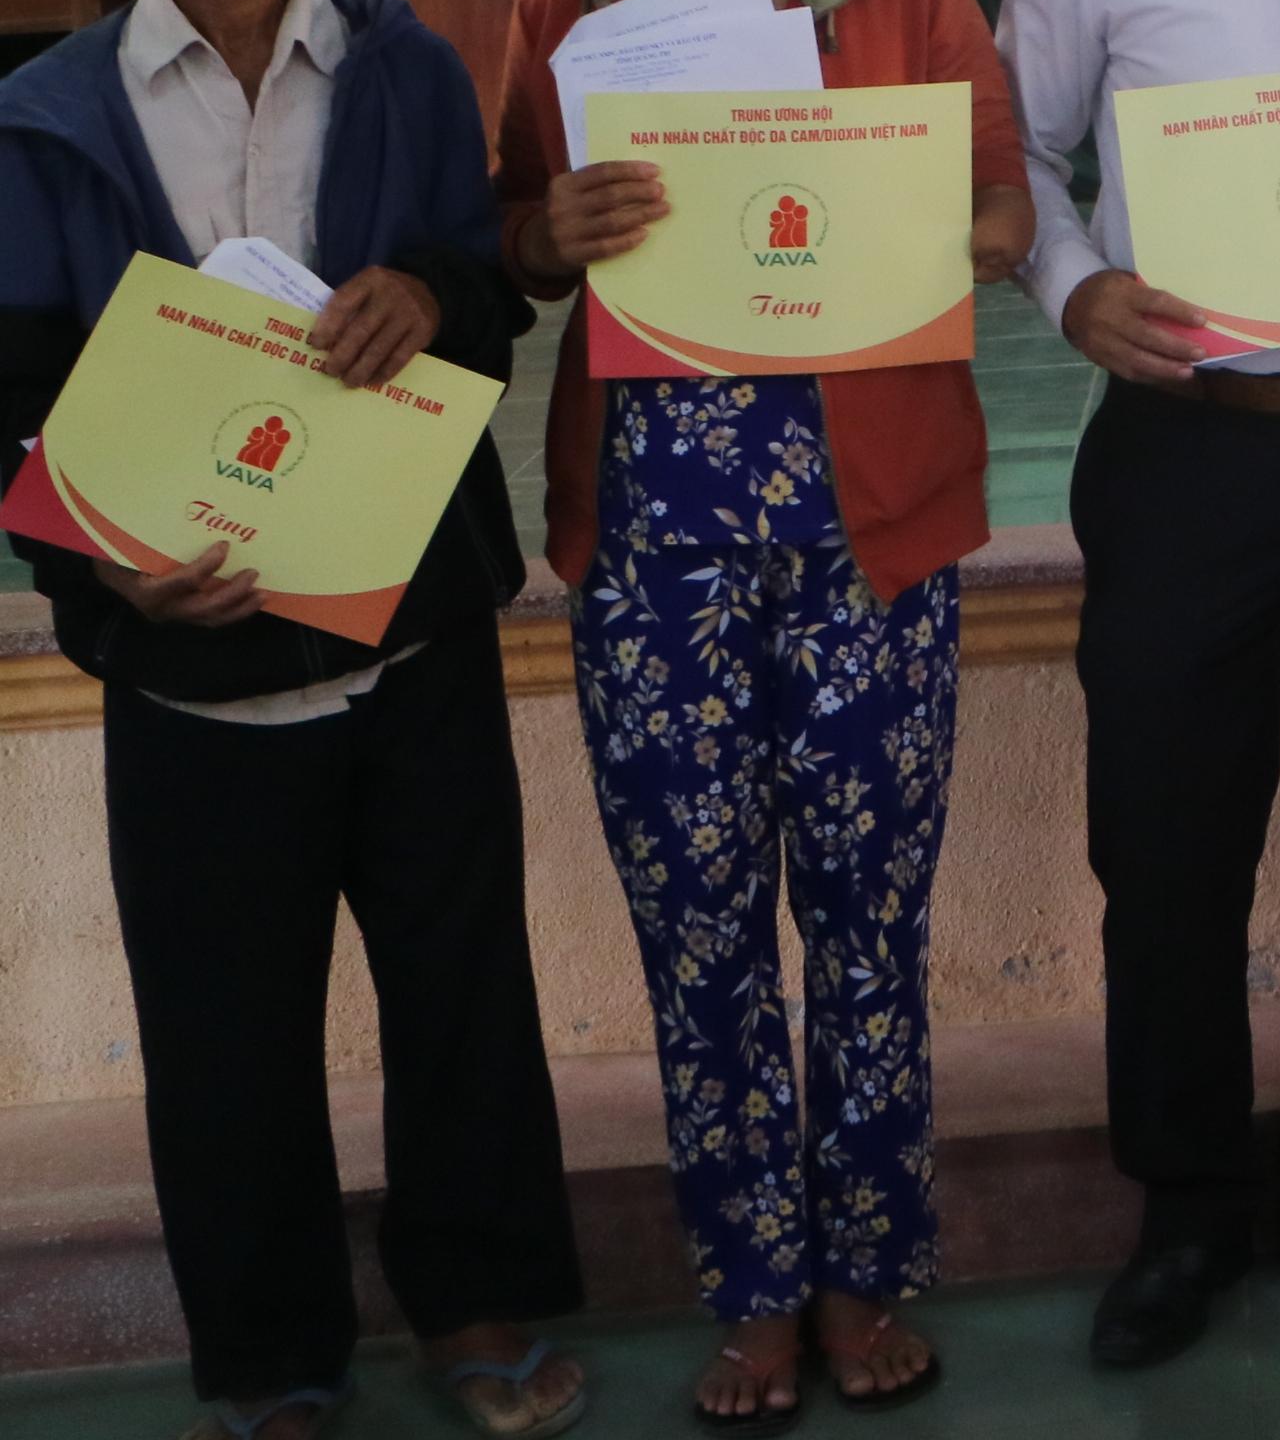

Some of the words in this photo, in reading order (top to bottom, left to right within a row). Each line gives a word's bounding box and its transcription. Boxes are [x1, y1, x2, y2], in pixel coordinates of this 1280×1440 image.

[730, 108, 771, 122] TRUNG
[774, 107, 808, 121] ƯƠNG
[811, 107, 832, 120] HỘI
[1162, 121, 1190, 137] NẠN
[1192, 115, 1228, 132] NHÂN
[1231, 109, 1262, 127] CHẤT
[630, 131, 659, 147] NẠN
[662, 128, 699, 144] NHÂN
[702, 127, 736, 144] CHẤT
[739, 130, 765, 144] ĐỘC
[769, 130, 787, 143] DA
[870, 125, 896, 139] VIỆT
[899, 123, 928, 137] NAM
[754, 252, 817, 266] VAVA
[749, 295, 821, 319] Tặng
[157, 304, 185, 324] NẠN
[187, 314, 226, 338] NHÂN
[227, 328, 262, 350] CHẤT
[262, 341, 289, 360] ĐỘC
[386, 384, 413, 405] VIỆT
[413, 395, 444, 417] NAM
[215, 461, 275, 493] VAVA
[187, 500, 257, 543] Tặng
